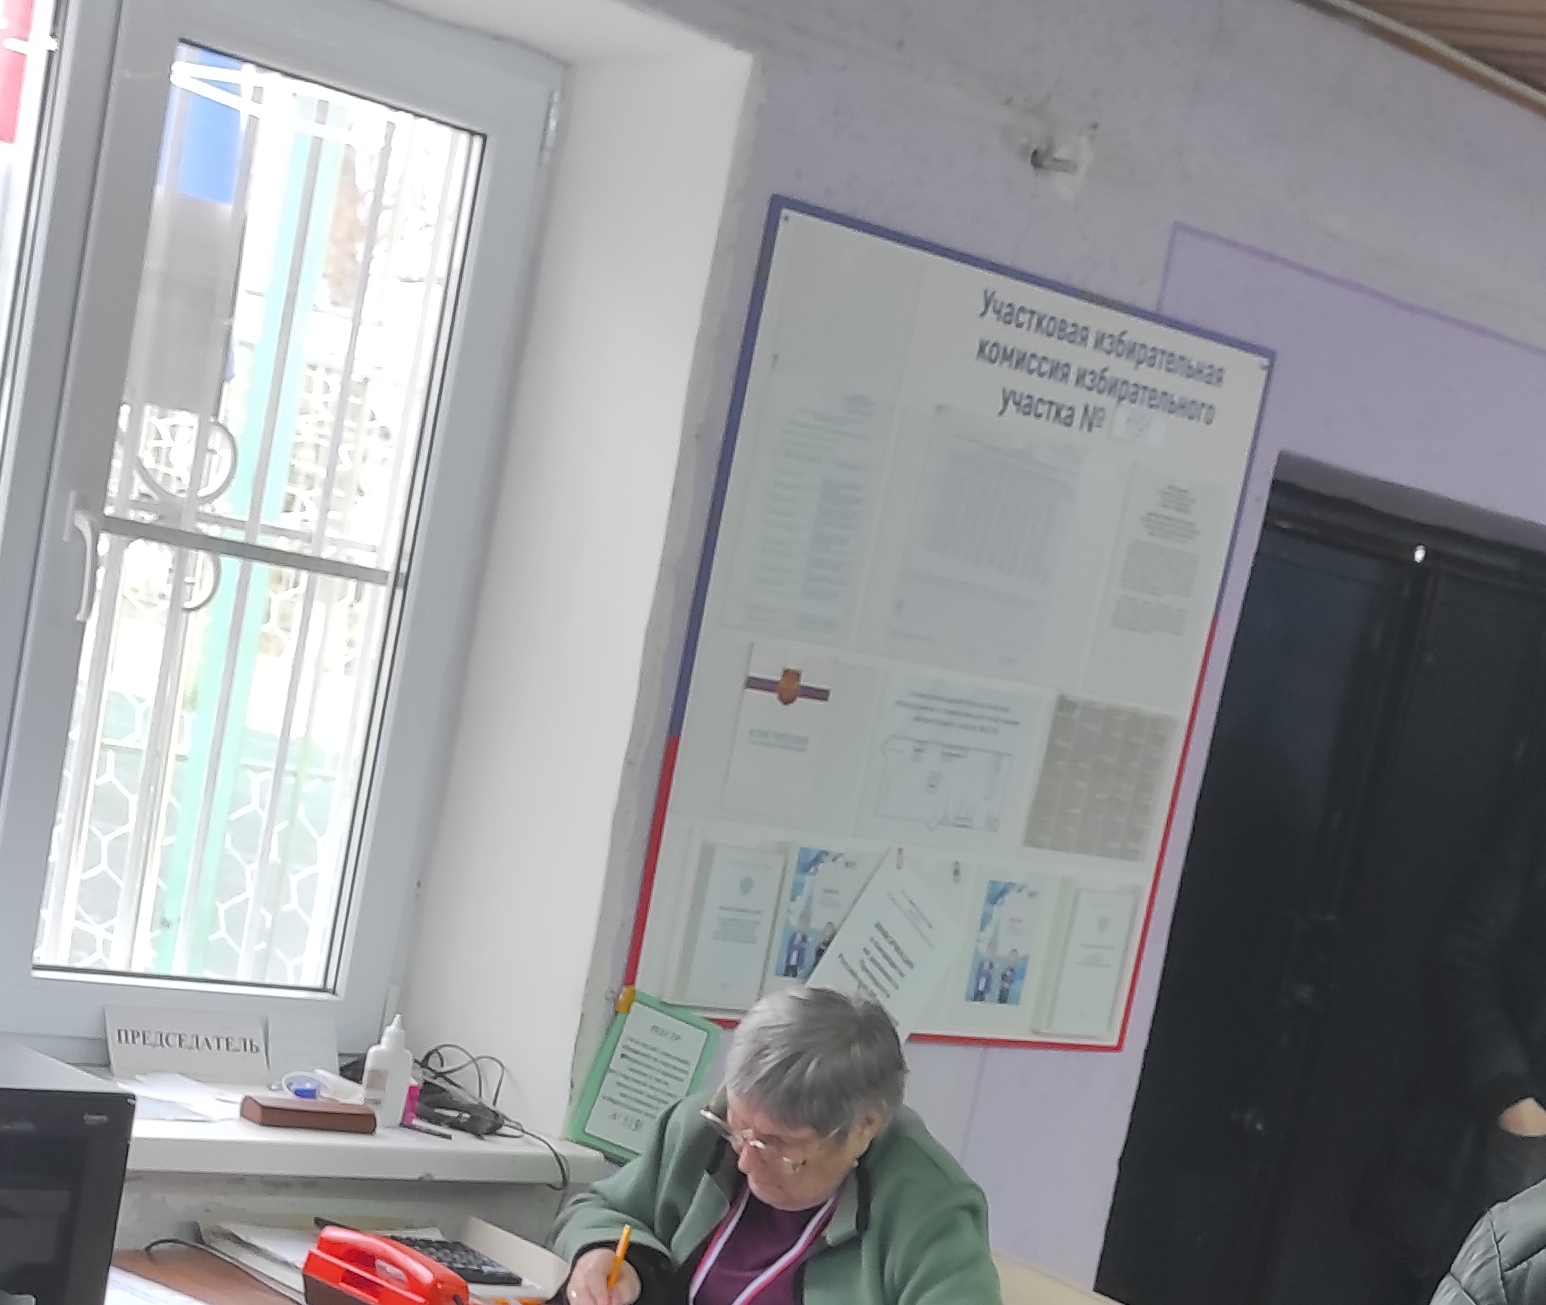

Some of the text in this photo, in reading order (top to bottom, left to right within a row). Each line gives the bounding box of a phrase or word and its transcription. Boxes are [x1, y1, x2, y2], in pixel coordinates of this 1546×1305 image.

[979, 289, 1226, 387] Участковая избирательная
[976, 338, 1216, 425] комиссия избирательного
[998, 387, 1075, 428] участка
[116, 1028, 261, 1053] ПРЕДСЕДАТЕЛЬ
